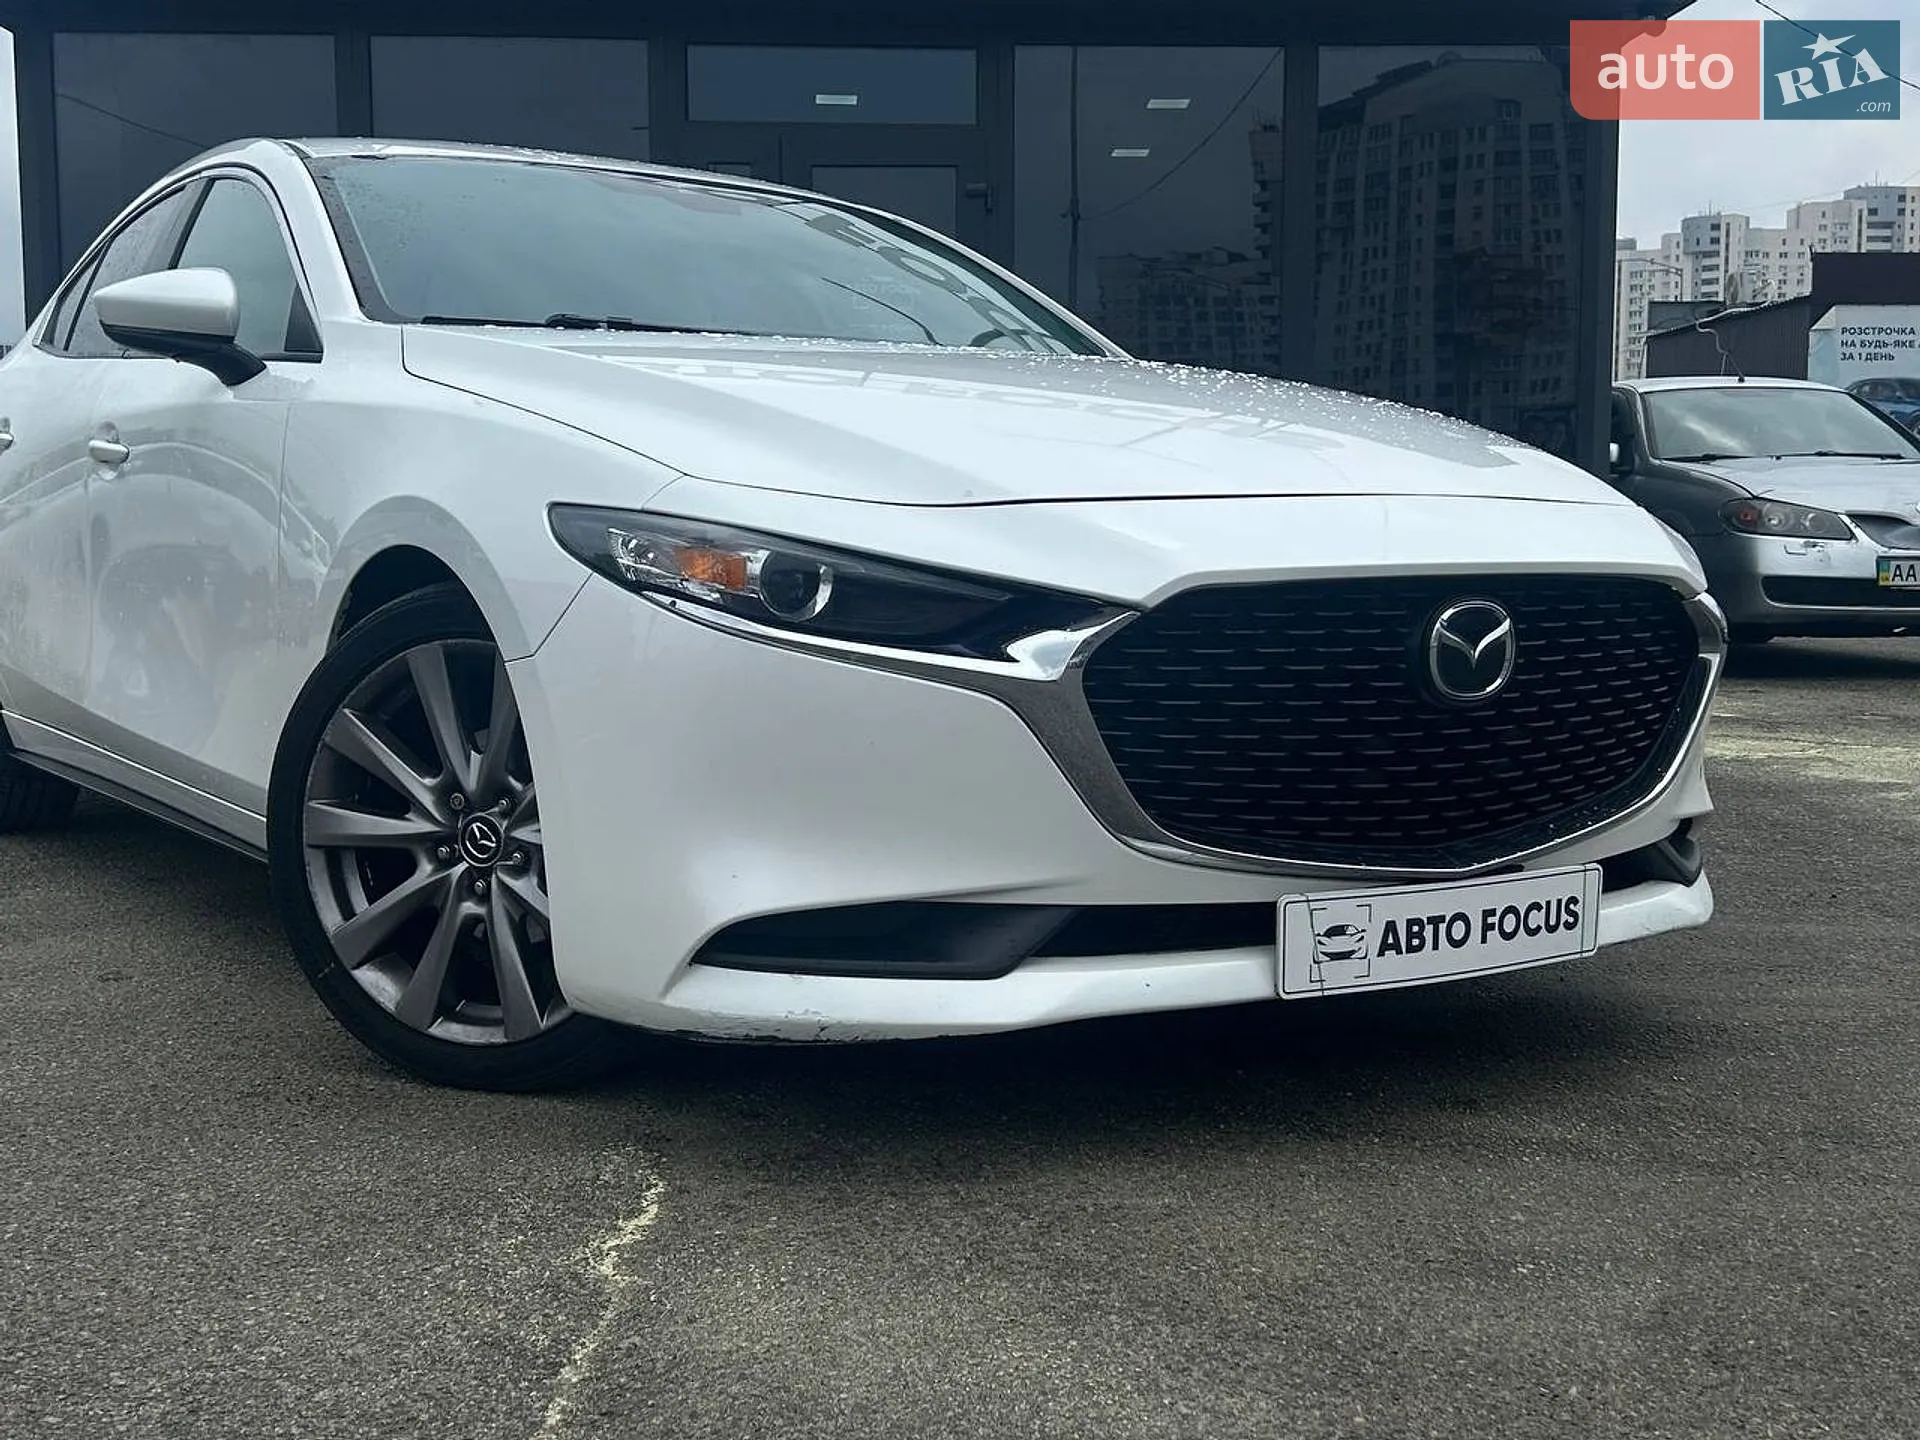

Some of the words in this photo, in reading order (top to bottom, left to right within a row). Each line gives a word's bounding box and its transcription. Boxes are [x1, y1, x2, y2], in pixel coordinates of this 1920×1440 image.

[1841, 327, 1916, 336] РОЗСТРОЧКА
[1840, 340, 1856, 349] НА
[1860, 340, 1915, 349] БУДЬ-ЯКЕ
[1840, 352, 1856, 361] ЗА
[1865, 352, 1895, 362] ДЕНЬ
[1376, 911, 1472, 958] АВТО
[1480, 895, 1581, 945] FOCUS
